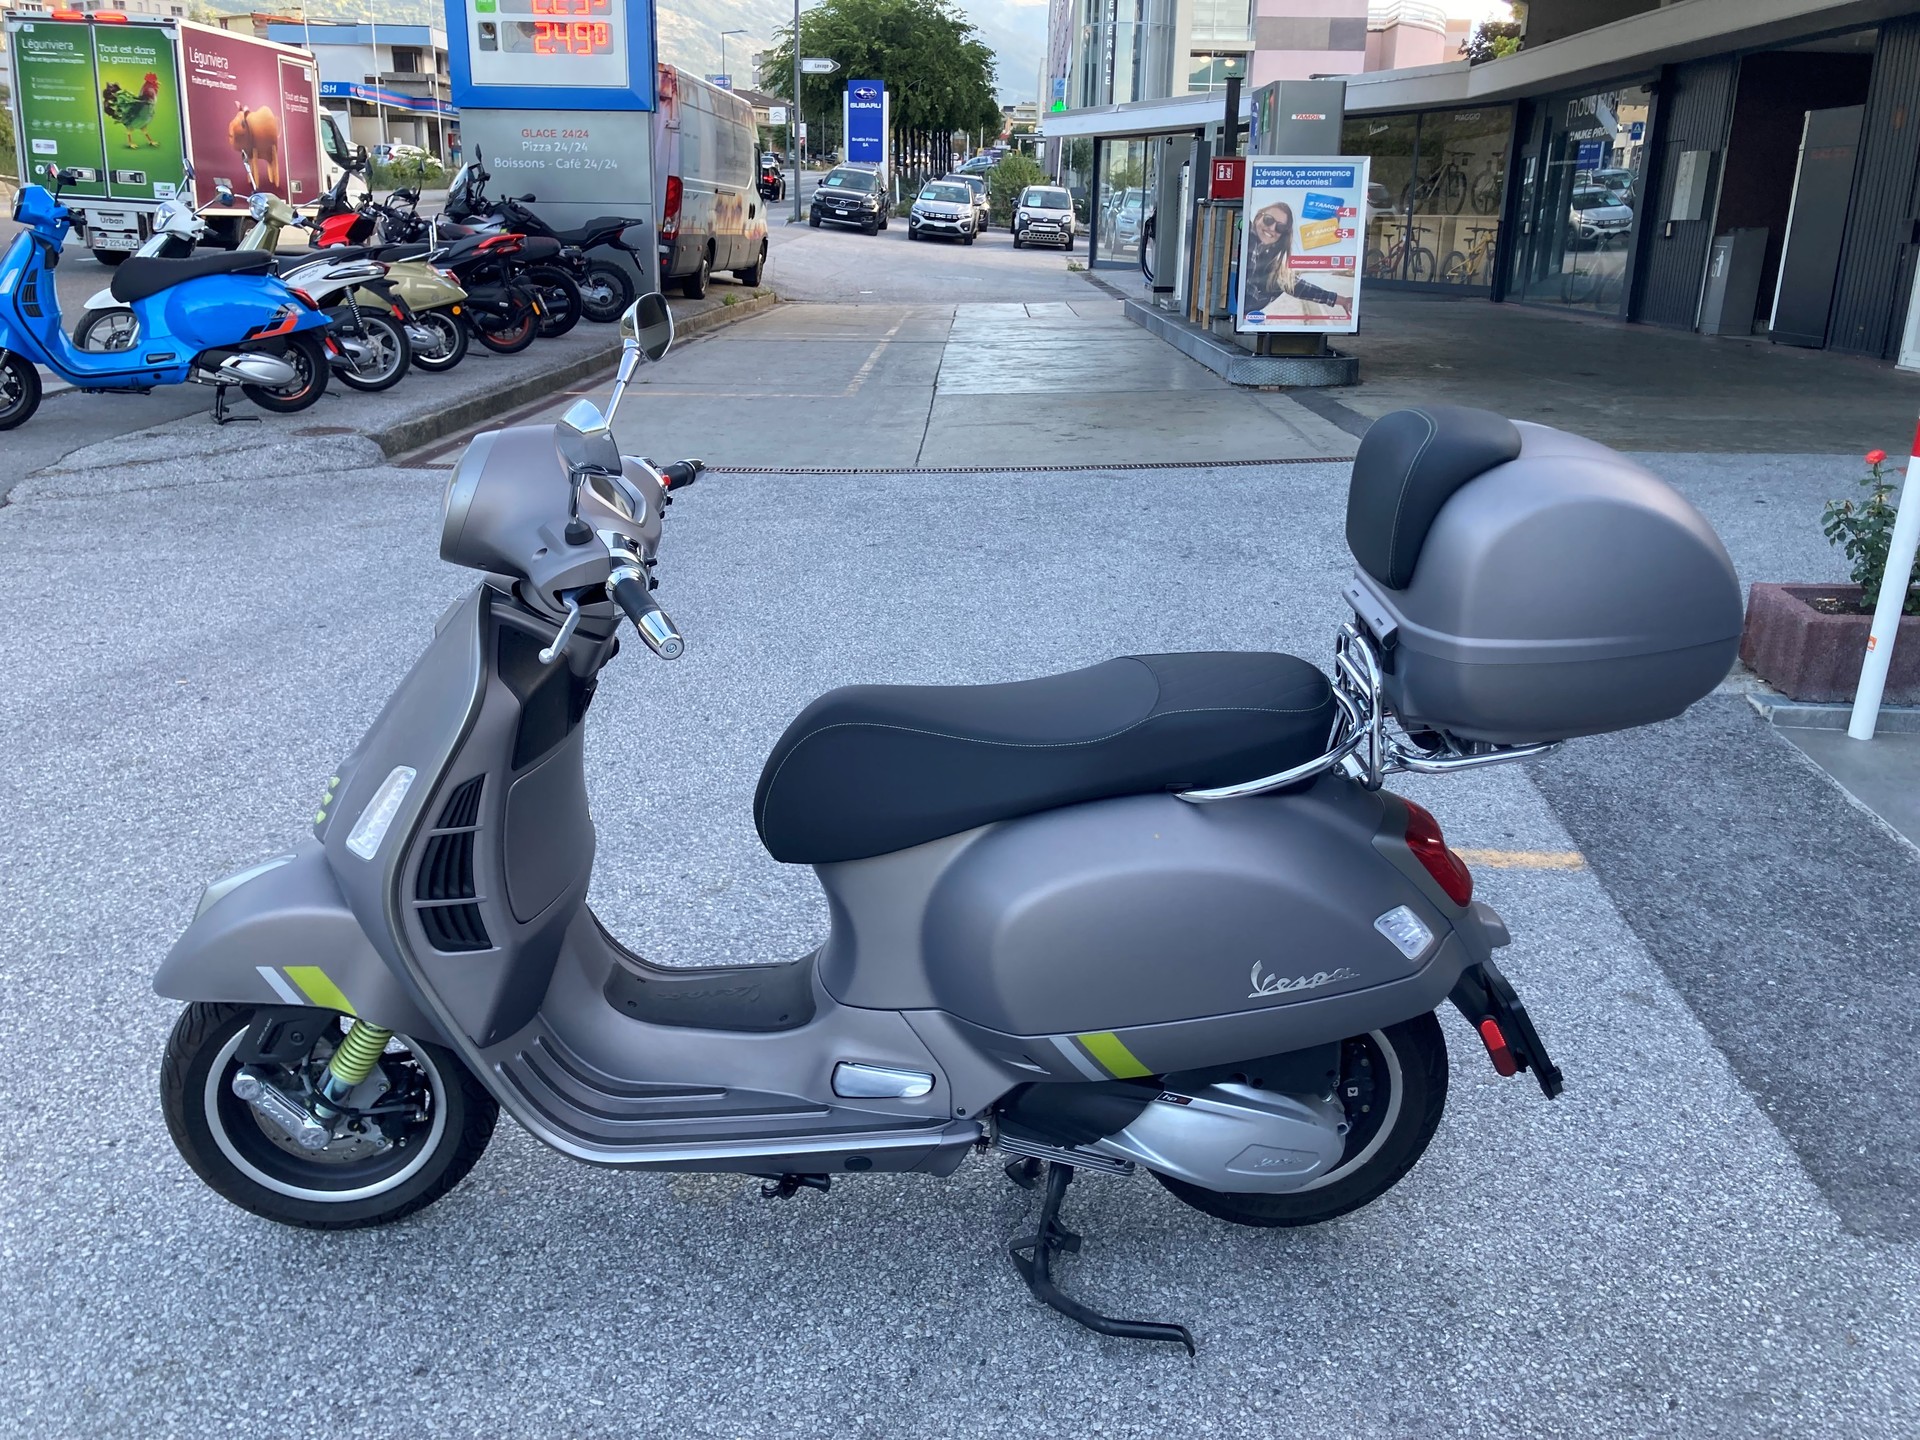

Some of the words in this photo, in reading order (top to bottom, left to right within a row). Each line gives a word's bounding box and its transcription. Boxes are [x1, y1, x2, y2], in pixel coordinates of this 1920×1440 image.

[21, 38, 74, 51] Léguriviera
[98, 43, 118, 53] Tout
[119, 45, 132, 54] est
[133, 45, 156, 55] dans
[99, 54, 109, 63] la
[188, 46, 229, 70] Léguriviera
[521, 129, 557, 138] GLACE
[1165, 136, 1173, 146] 4
[521, 141, 552, 152] Pizza
[553, 142, 588, 154] 24/24
[494, 157, 546, 169] Boissons
[555, 158, 582, 169] Café
[583, 159, 618, 171] 24/24
[1255, 168, 1294, 178] L'évasion,
[1295, 169, 1306, 178] ça
[1306, 169, 1352, 177] commence
[1254, 178, 1269, 187] par
[1269, 178, 1285, 186] des
[100, 217, 124, 225] Urban
[1248, 960, 1361, 999] Vespa
